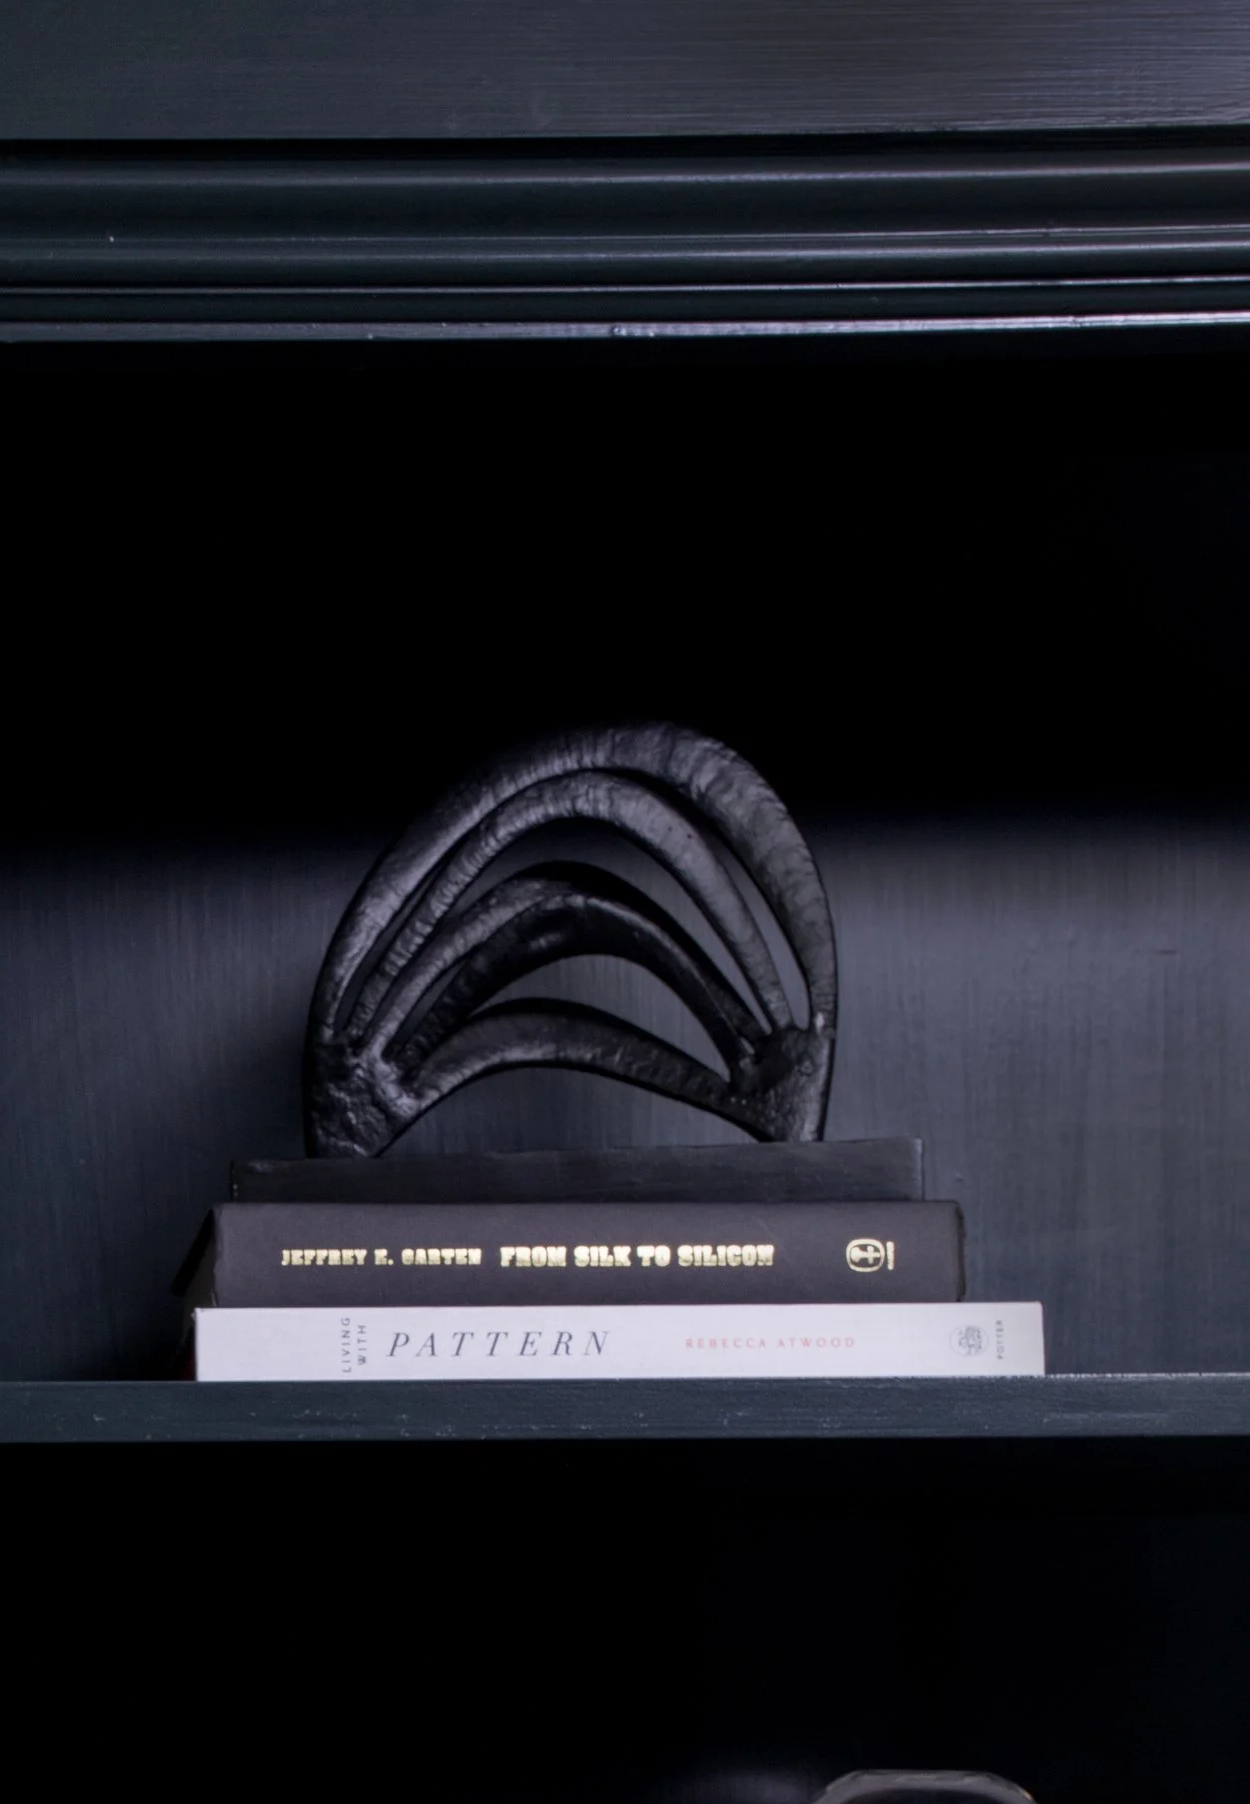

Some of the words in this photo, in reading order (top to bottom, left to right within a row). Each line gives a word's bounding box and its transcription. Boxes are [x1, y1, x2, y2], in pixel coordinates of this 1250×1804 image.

[281, 1248, 368, 1266] JEFFREY
[374, 1248, 394, 1266] E.
[500, 1246, 567, 1268] FROM
[573, 1245, 631, 1268] SILK
[636, 1245, 671, 1267] TO
[677, 1244, 775, 1267] SILICON
[340, 1317, 352, 1373] LIVING
[357, 1324, 367, 1366] WITH
[386, 1331, 611, 1358] PATTERN
[685, 1337, 767, 1350] REBECCA
[777, 1336, 856, 1349] ATWOOD
